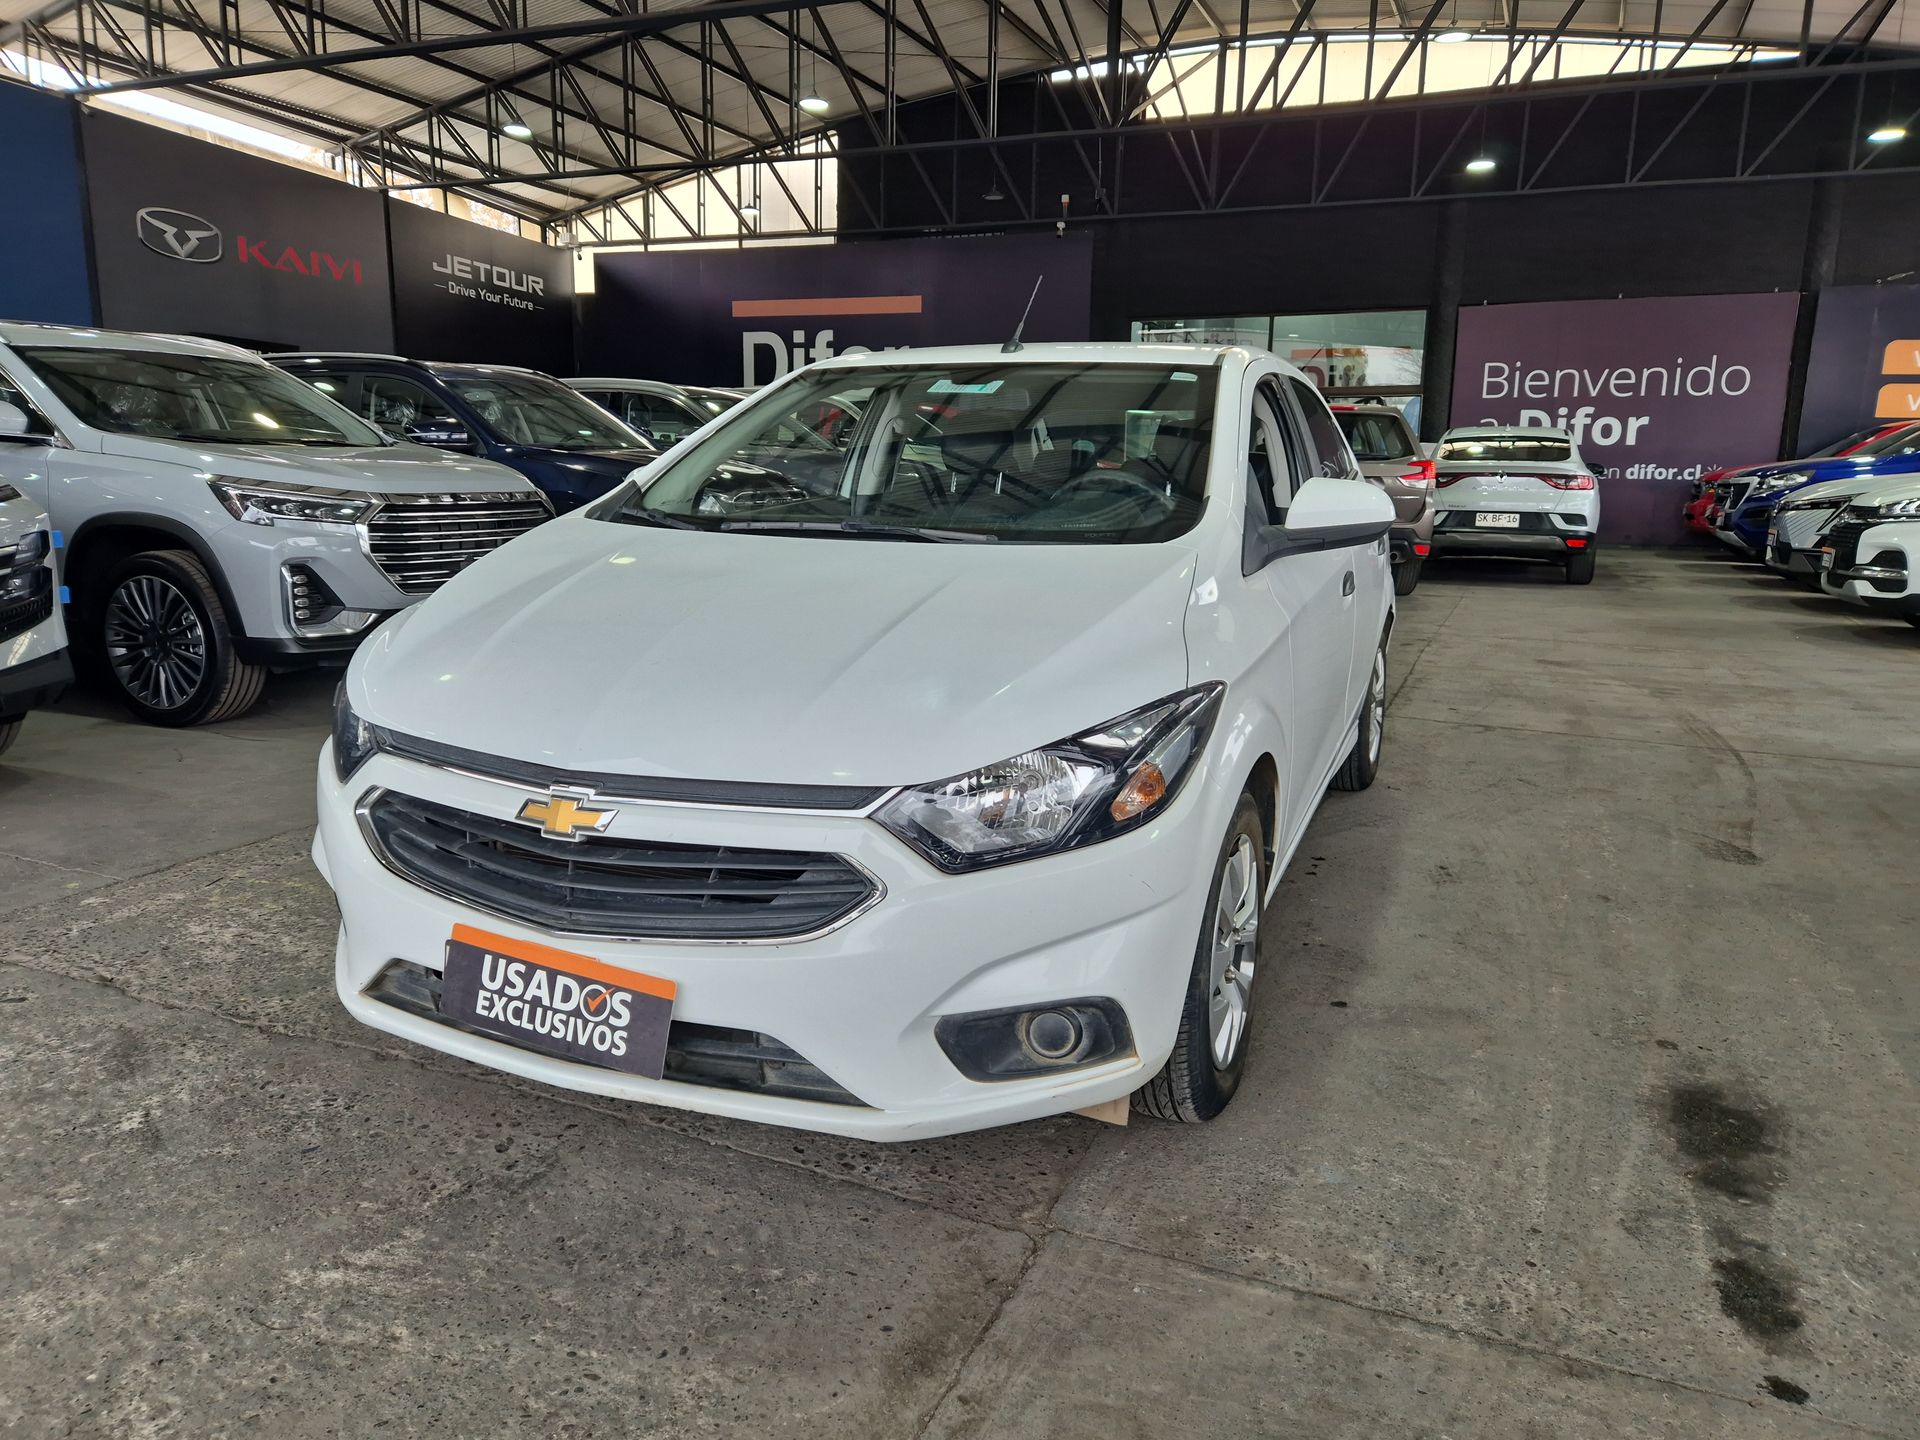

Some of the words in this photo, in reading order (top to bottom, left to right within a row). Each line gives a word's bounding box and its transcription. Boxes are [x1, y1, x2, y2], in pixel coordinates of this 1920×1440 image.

[432, 253, 545, 297] JETOUR
[448, 281, 477, 299] Drive
[478, 287, 502, 304] Your
[503, 293, 534, 311] Future
[1481, 355, 1751, 399] Bienvenido
[481, 954, 632, 1027] USADOS
[475, 989, 628, 1056] EXCLUSIVOS
